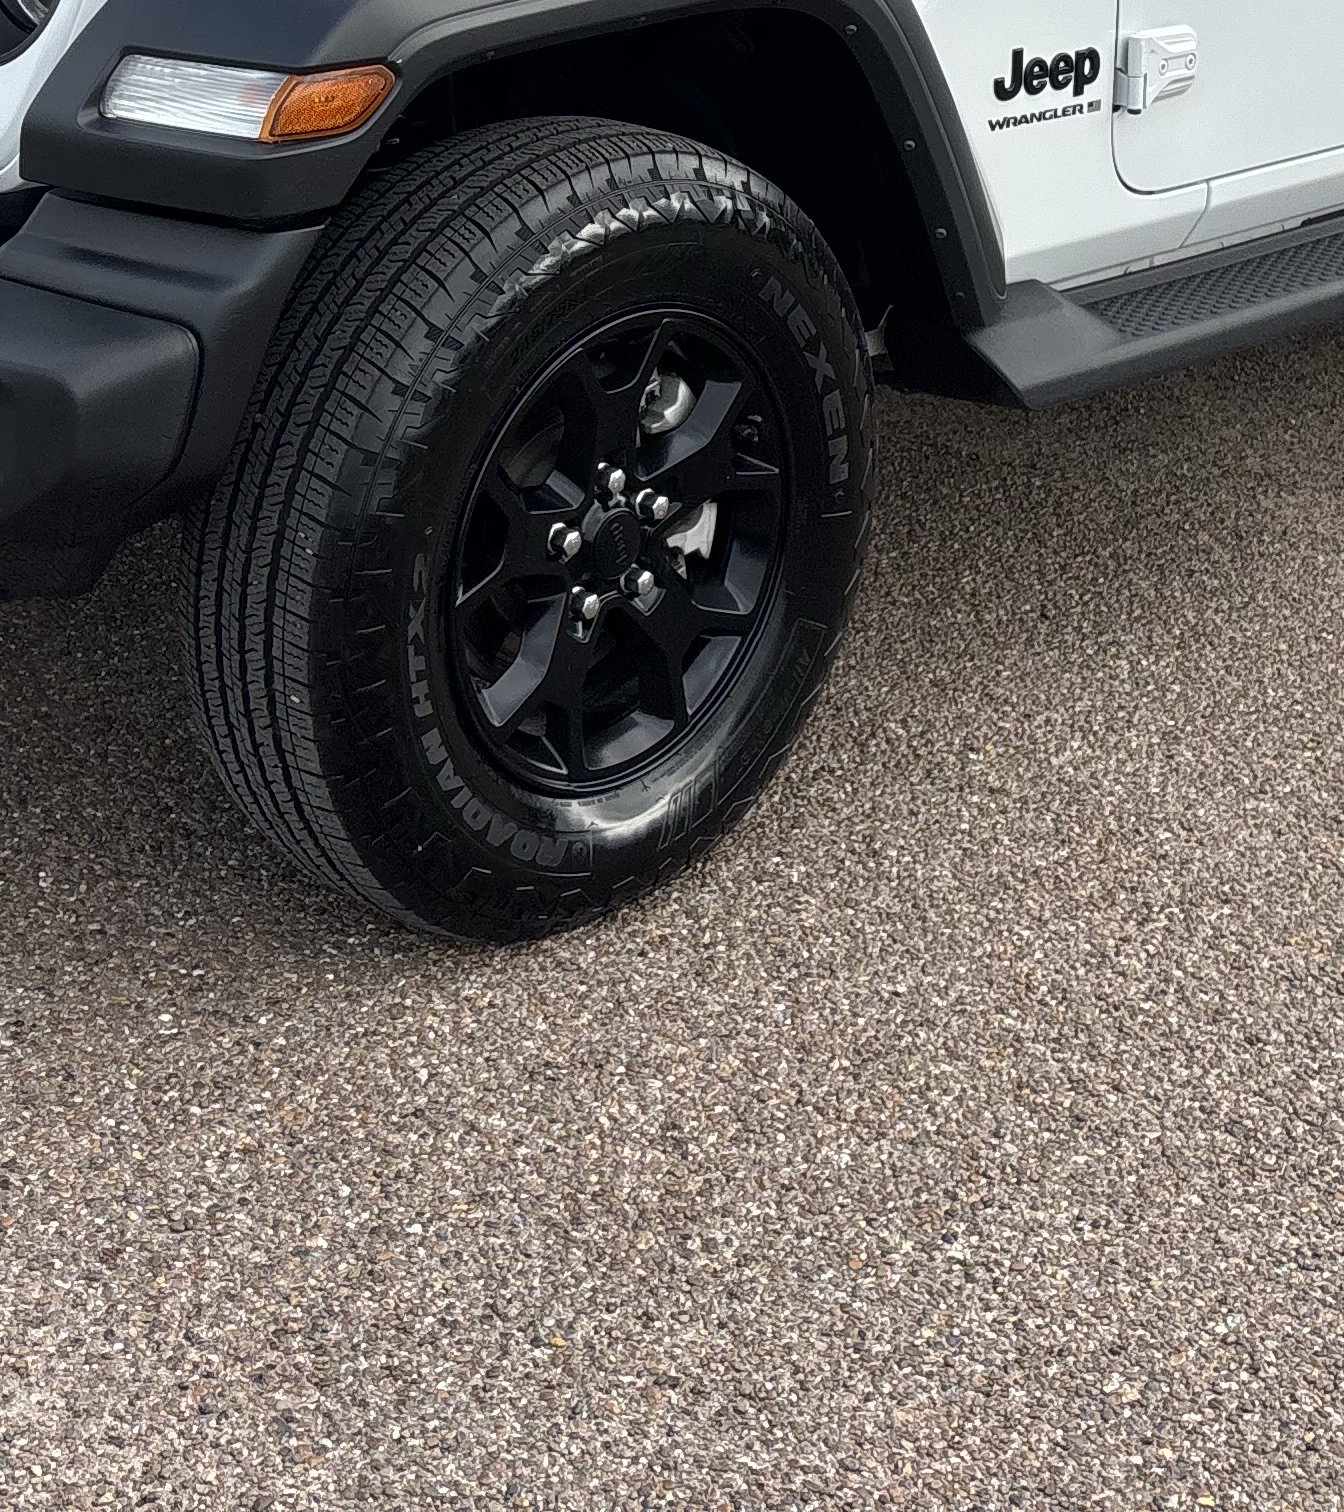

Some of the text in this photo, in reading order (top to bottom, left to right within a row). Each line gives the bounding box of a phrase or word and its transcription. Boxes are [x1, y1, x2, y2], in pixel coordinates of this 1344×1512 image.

[987, 102, 1084, 131] WRANGLER
[993, 46, 1101, 102] Jeep
[758, 275, 849, 485] NEXEN
[420, 727, 569, 867] ROADIAN
